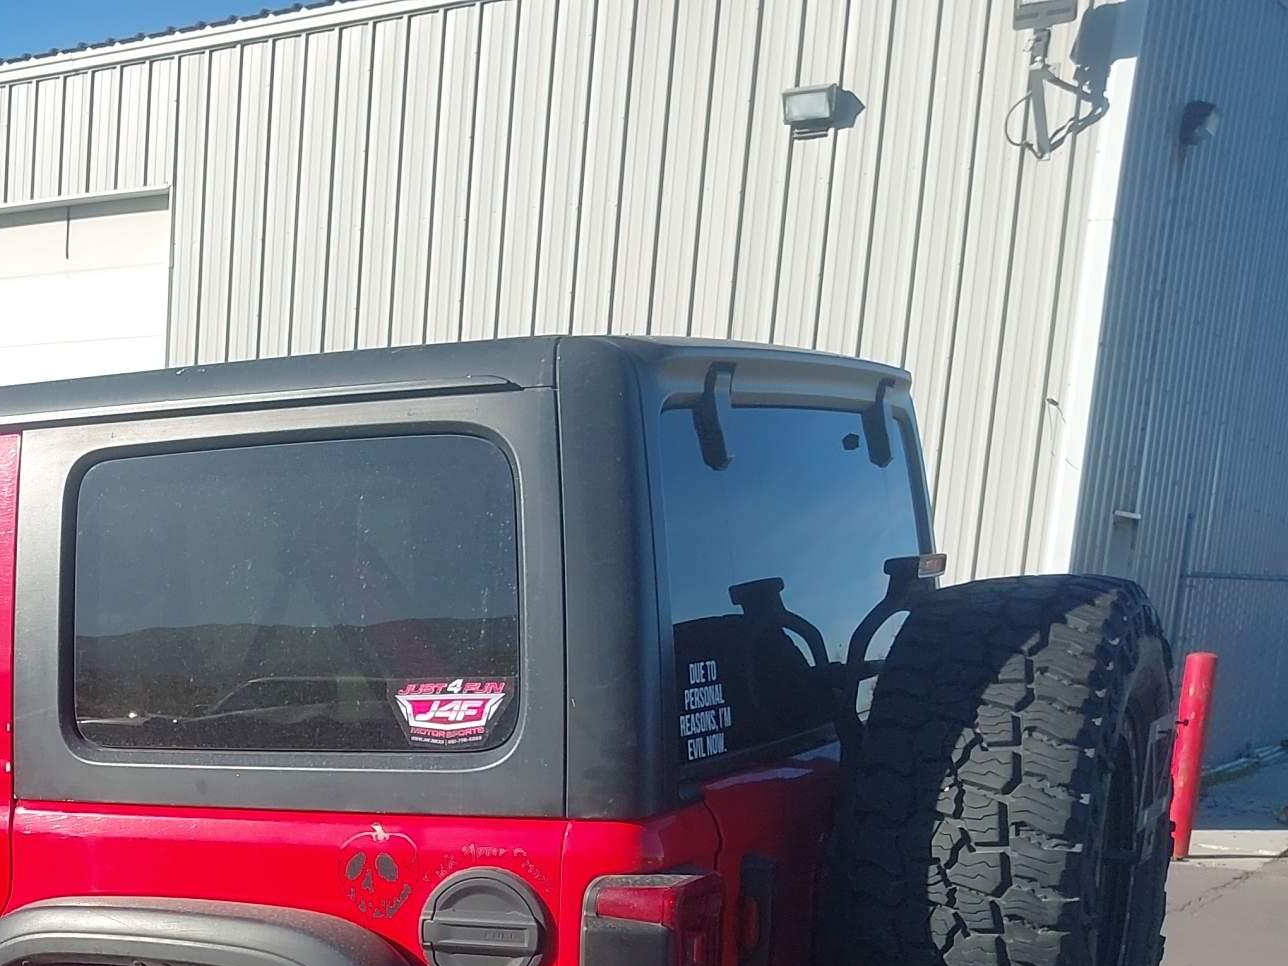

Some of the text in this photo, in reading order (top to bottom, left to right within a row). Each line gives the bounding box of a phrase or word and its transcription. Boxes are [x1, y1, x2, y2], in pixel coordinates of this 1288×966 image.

[689, 660, 717, 684] DUE TO
[398, 678, 506, 696] JUST 4 FUN
[684, 684, 726, 711] PERSONAL
[414, 700, 485, 722] J4F
[679, 706, 732, 737] REASONS, I'M
[687, 732, 728, 761] EVIL NOW.
